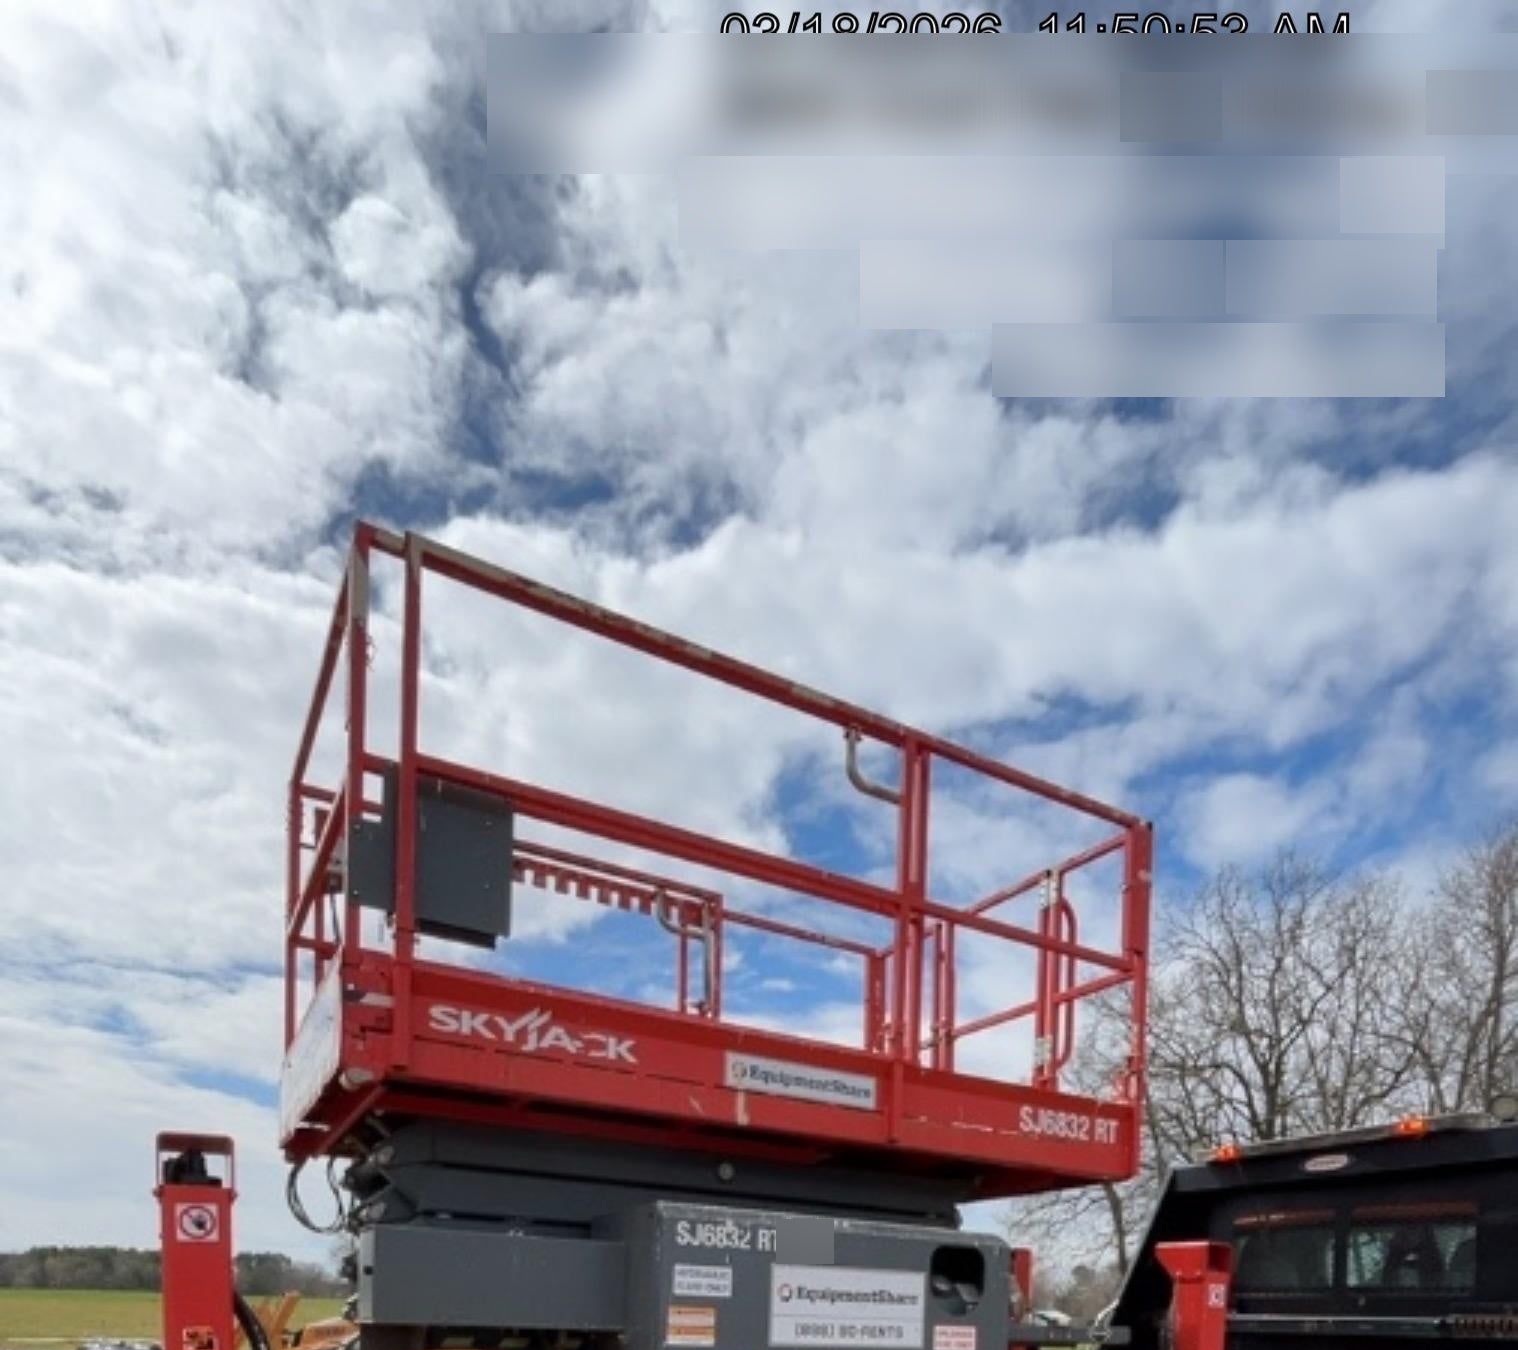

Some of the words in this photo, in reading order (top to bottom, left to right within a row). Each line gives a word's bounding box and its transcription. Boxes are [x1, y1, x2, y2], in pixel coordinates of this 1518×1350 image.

[428, 1003, 639, 1064] SKYJACK
[749, 1063, 871, 1099] EquipmentShare
[1019, 1105, 1090, 1141] SJ6832
[1094, 1117, 1119, 1144] RT
[675, 1220, 752, 1249] SJ6832
[796, 1286, 919, 1305] EquipmentShare
